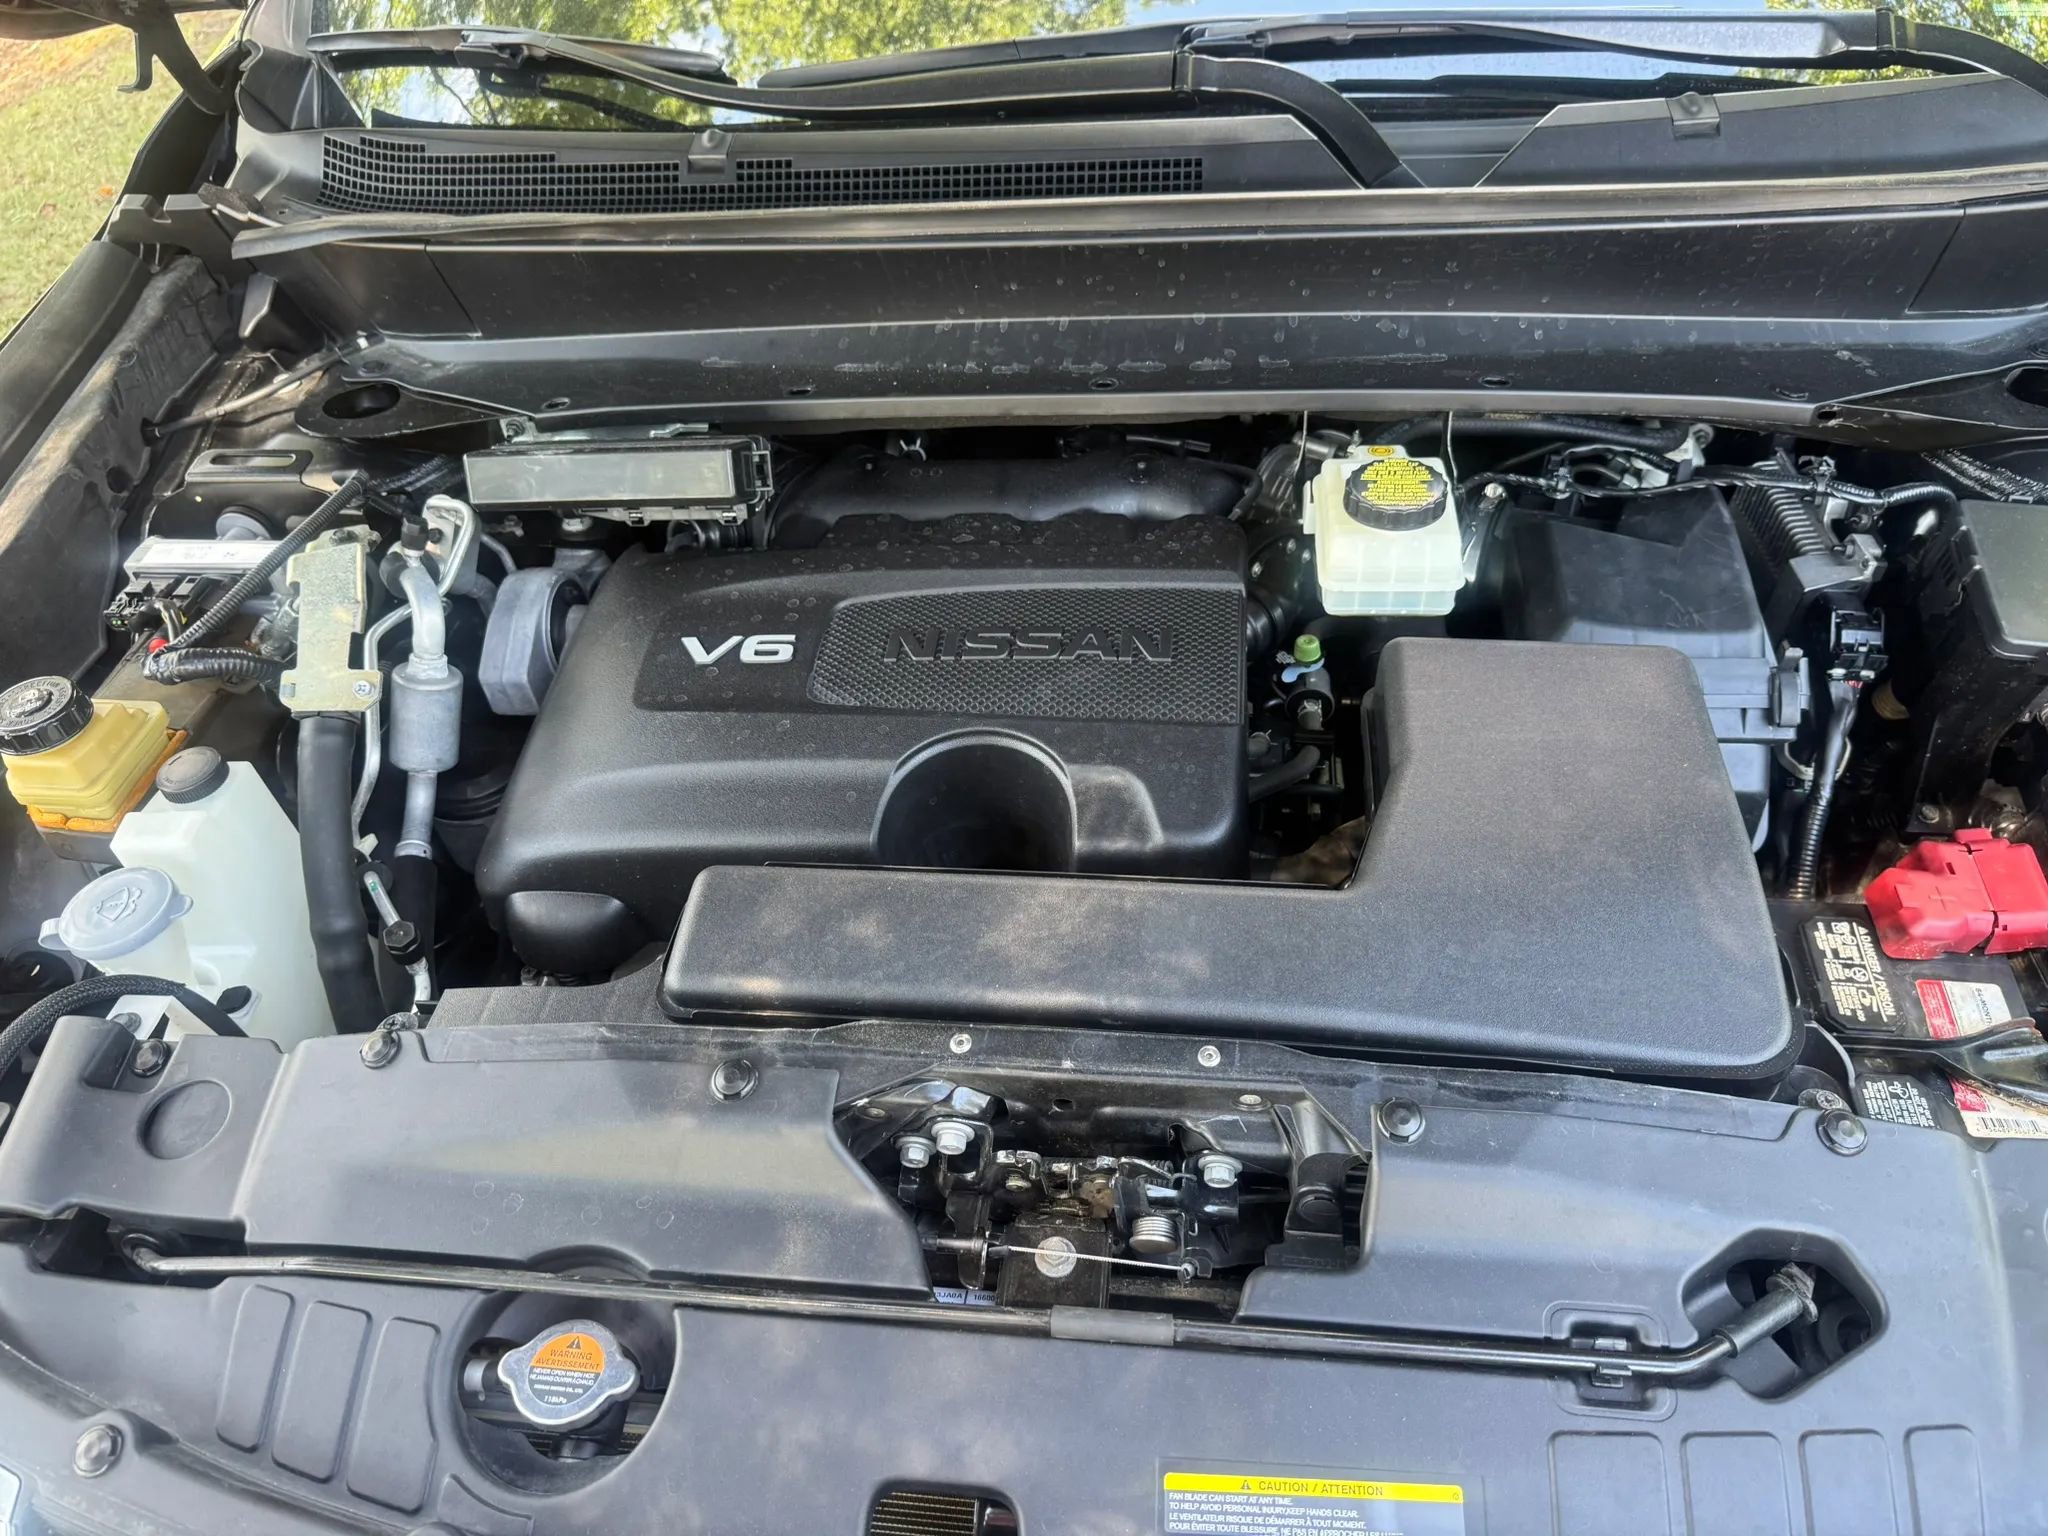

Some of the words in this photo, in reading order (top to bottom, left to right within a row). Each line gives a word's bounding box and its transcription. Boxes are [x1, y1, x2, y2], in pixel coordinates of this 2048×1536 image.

[681, 633, 796, 665] V6
[884, 625, 1174, 663] NISSAN
[1860, 934, 1882, 973] DANGER
[1875, 980, 1896, 1015] POISON
[550, 1349, 592, 1360] WARNING
[536, 1357, 600, 1370] AVERTISSEMENT
[1258, 1480, 1308, 1493] CAUTION
[1321, 1483, 1383, 1496] ATTENTION
[1169, 1492, 1183, 1500] FAN
[1184, 1493, 1208, 1501] BLADE
[1225, 1494, 1248, 1503] START
[1181, 1502, 1199, 1510] HELP
[1200, 1503, 1221, 1511] AVOID
[1223, 1504, 1262, 1513] PERSONAL
